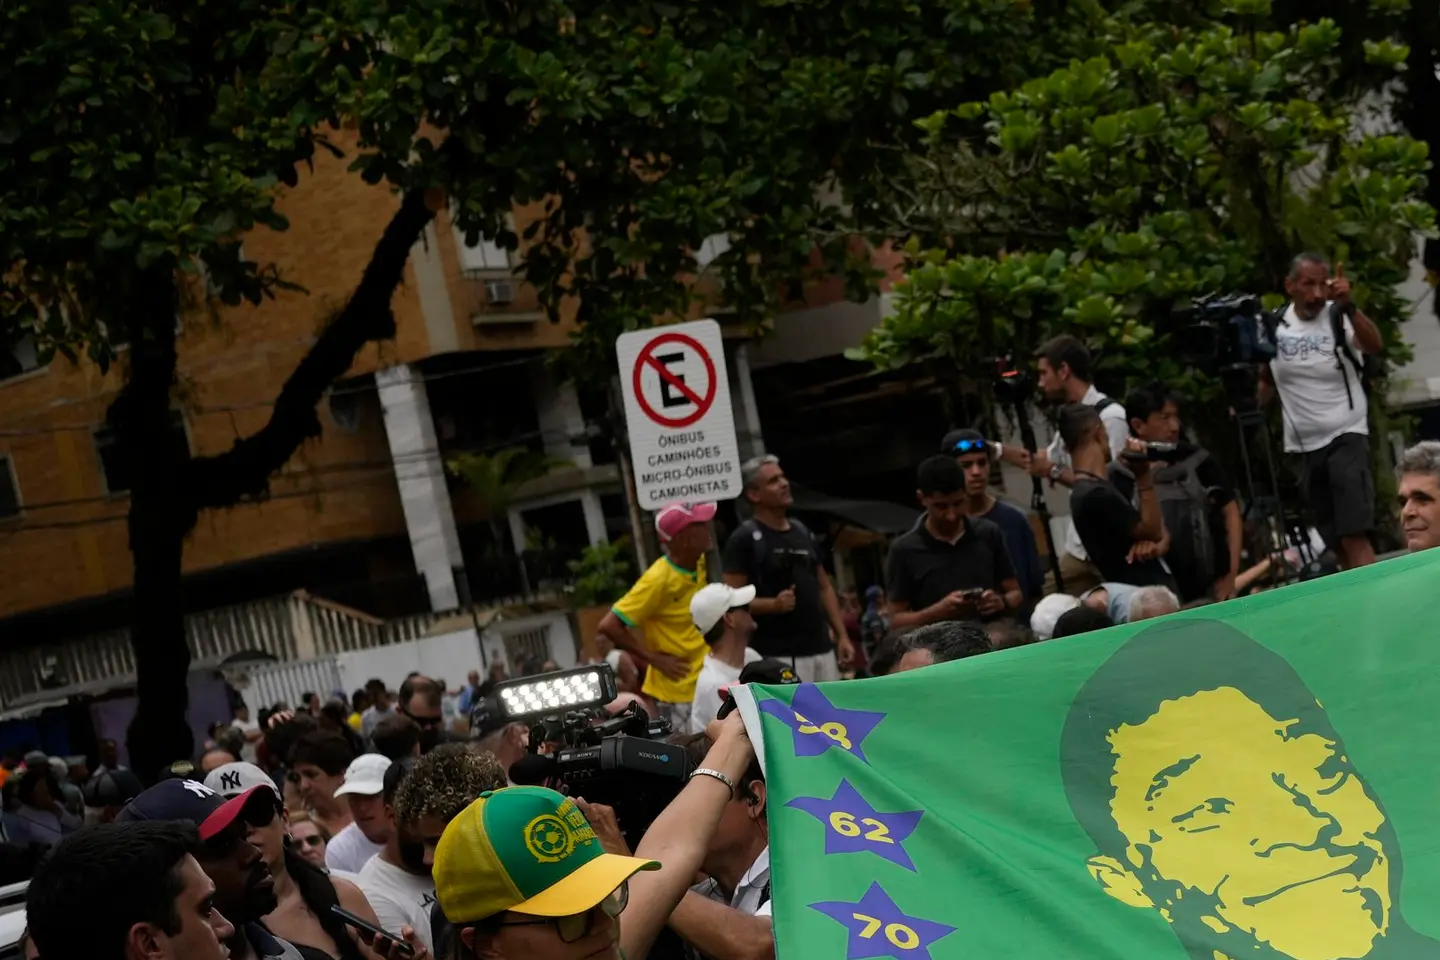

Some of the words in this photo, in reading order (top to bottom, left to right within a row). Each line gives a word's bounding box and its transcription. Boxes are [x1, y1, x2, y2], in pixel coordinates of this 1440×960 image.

[656, 352, 691, 408] E
[658, 431, 705, 448] ÔNIBUS
[648, 445, 721, 467] CAMINHÕES
[641, 461, 732, 484] MICRO-ÔNIBUS
[649, 479, 729, 501] CAMIONETAS
[220, 770, 242, 790] NY
[829, 811, 895, 844] 62
[852, 912, 921, 950] 70
